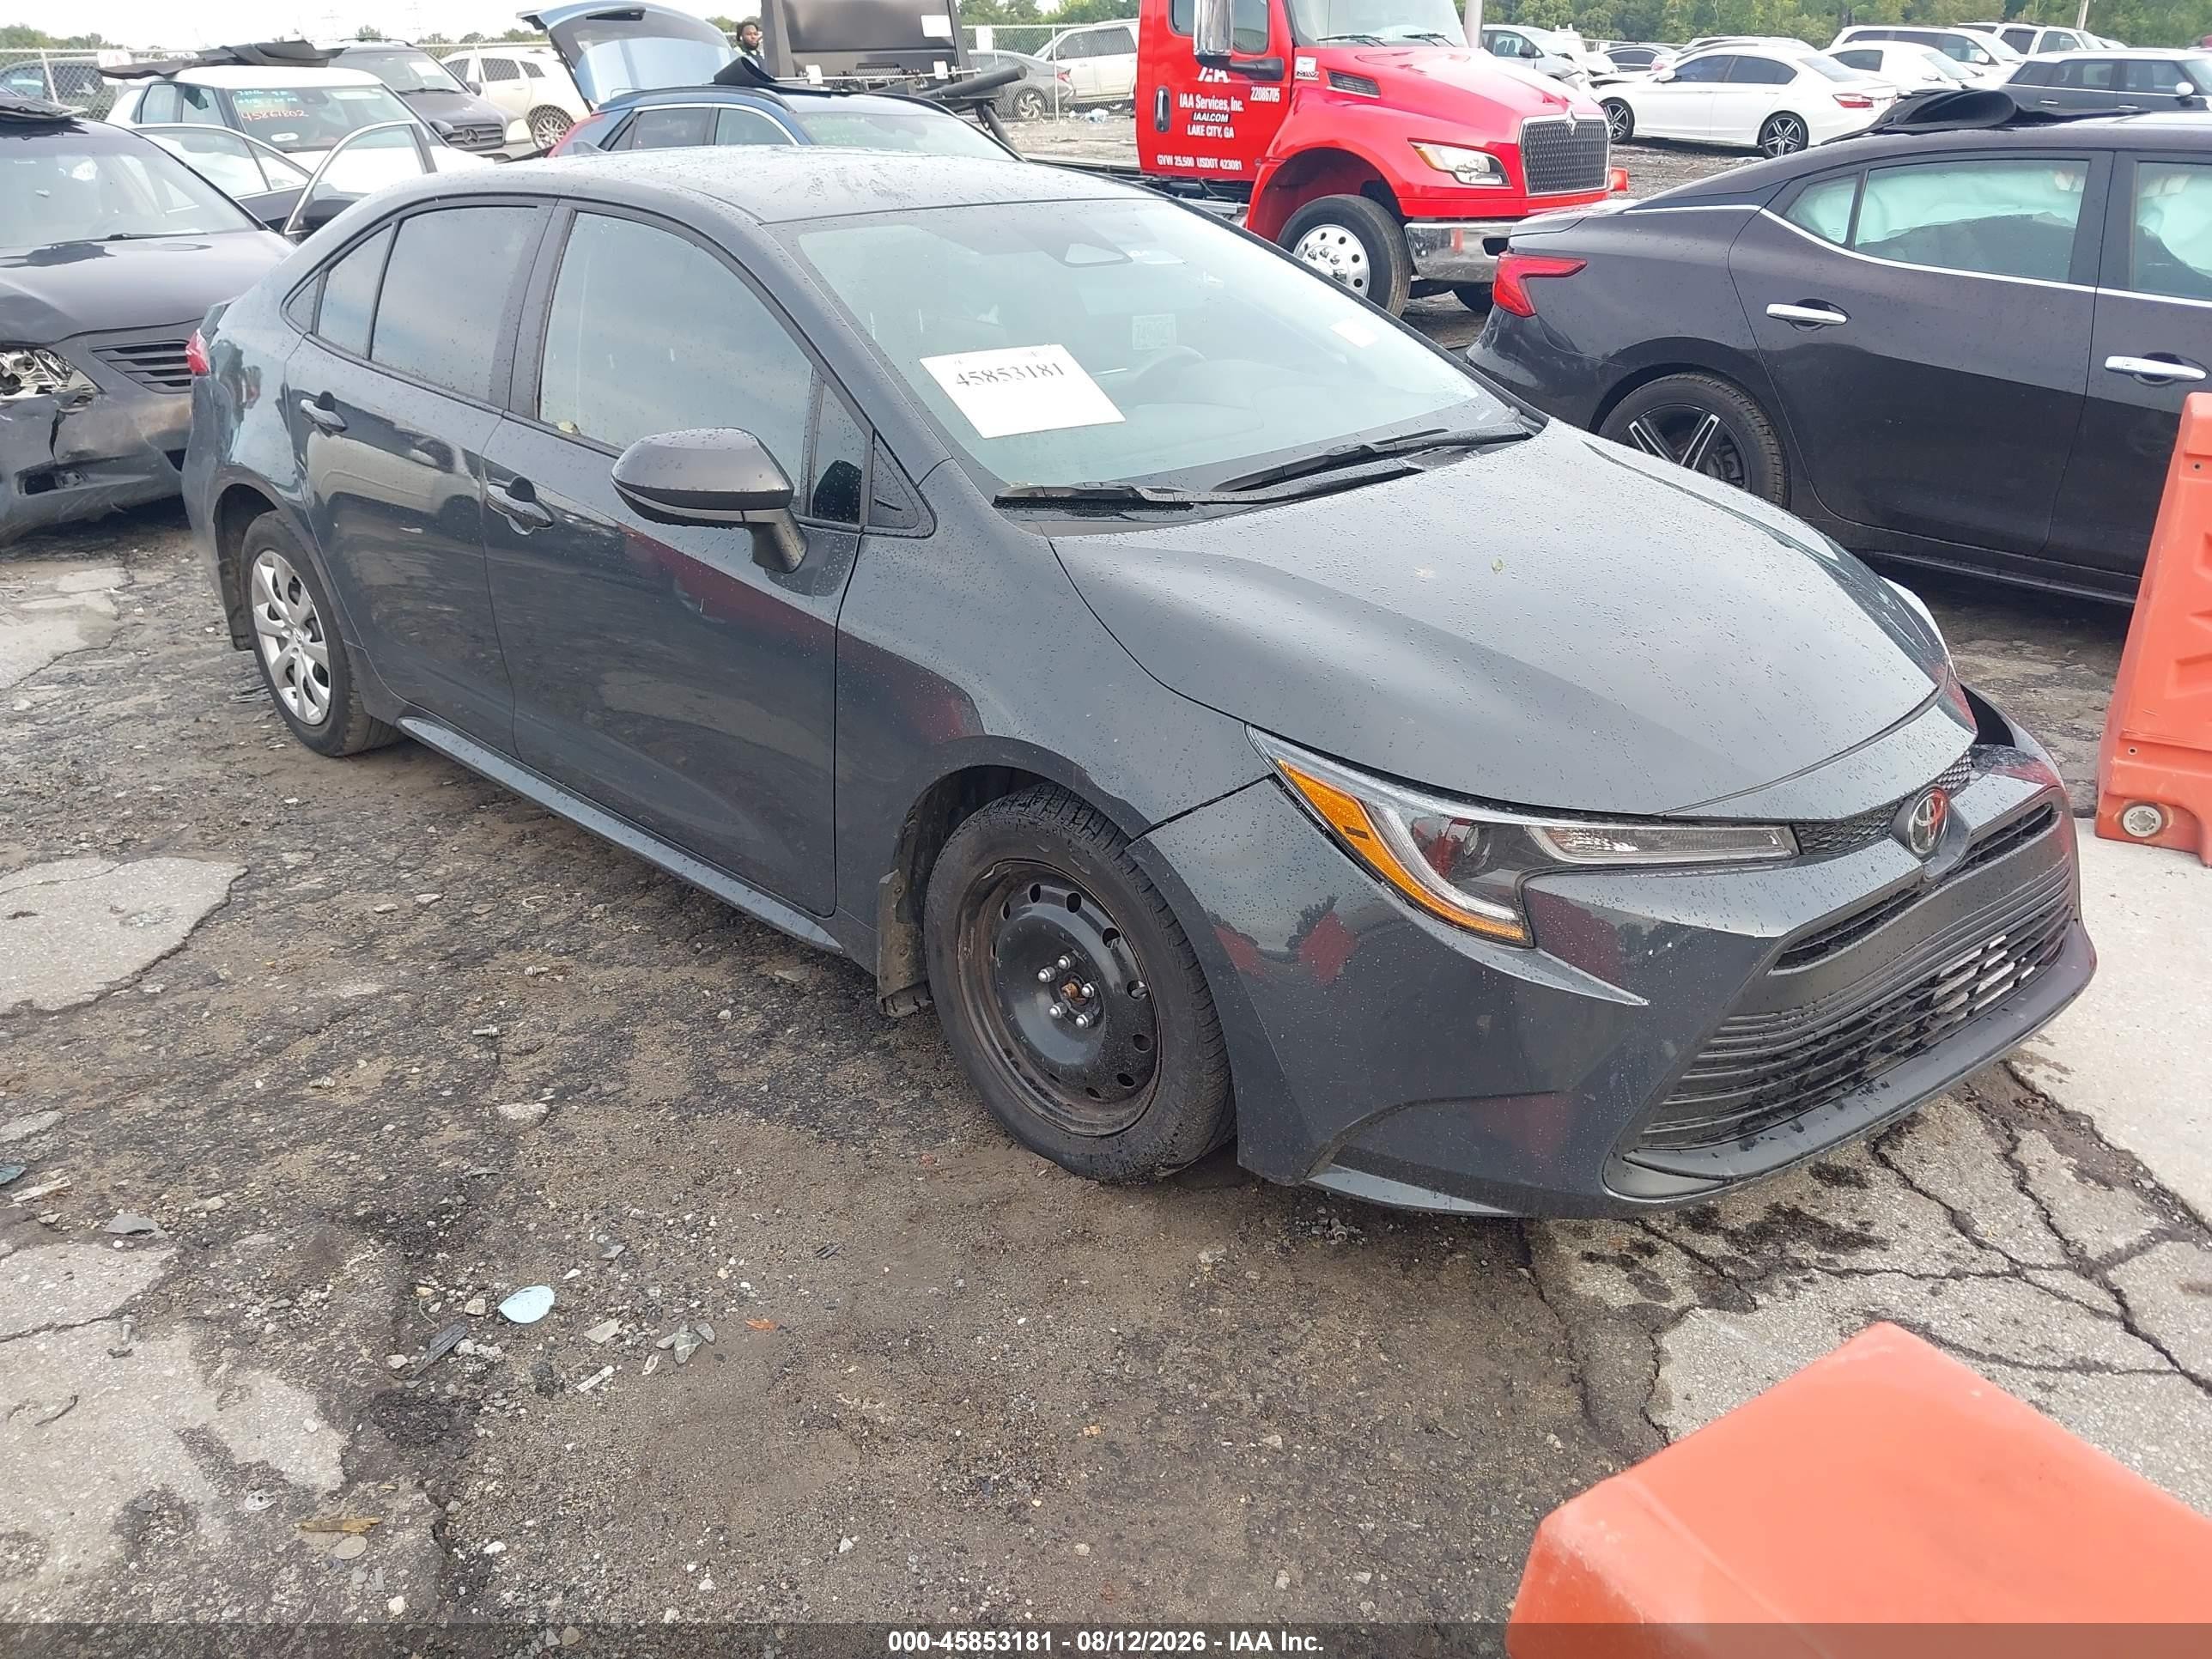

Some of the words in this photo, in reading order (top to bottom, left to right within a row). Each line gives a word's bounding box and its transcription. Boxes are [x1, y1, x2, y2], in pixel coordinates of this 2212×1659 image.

[1250, 86, 1280, 102] 22086705
[1179, 93, 1194, 108] IAA
[1195, 94, 1230, 112] Services,
[1231, 96, 1244, 112] Inc.
[1194, 112, 1229, 123] IAAI.COM
[1188, 125, 1205, 136] LAKE
[1206, 125, 1223, 137] CITY,
[1224, 126, 1235, 138] GA
[1157, 155, 1174, 166] GVW
[1196, 157, 1218, 169] USDOT
[956, 362, 1064, 386] 45853181
